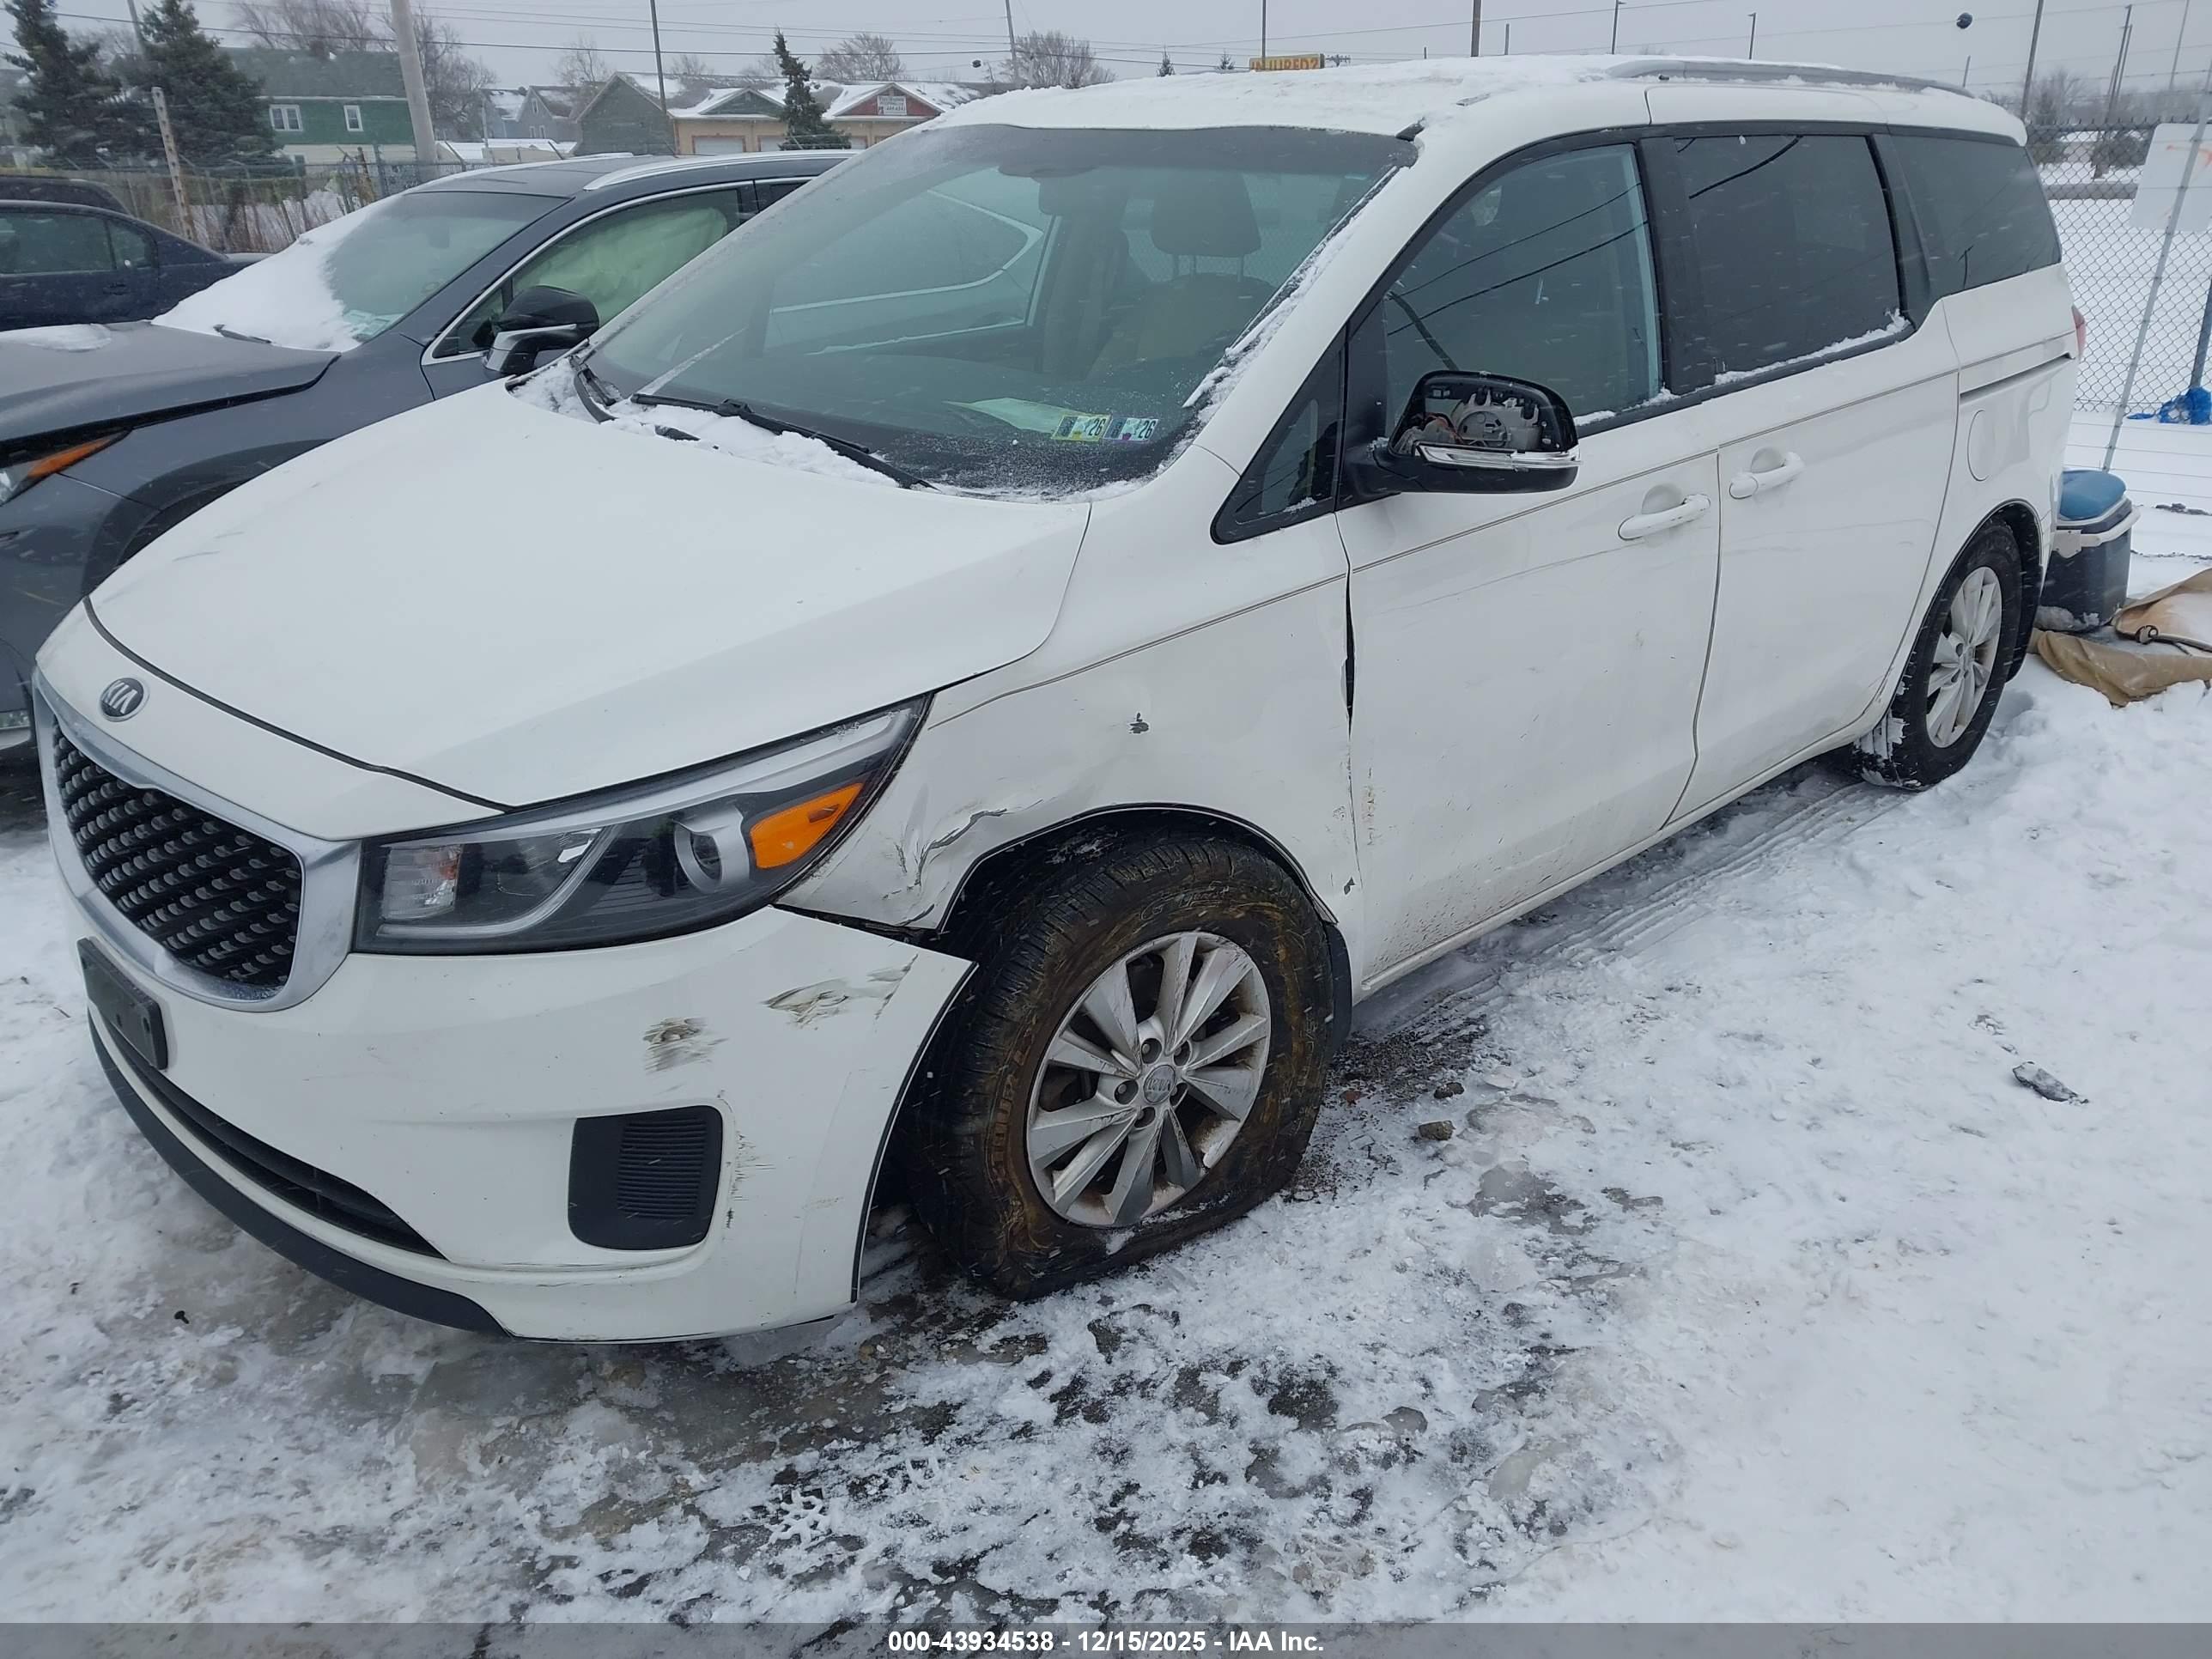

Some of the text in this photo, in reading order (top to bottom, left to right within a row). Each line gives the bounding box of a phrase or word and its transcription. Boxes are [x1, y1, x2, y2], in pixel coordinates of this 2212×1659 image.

[1089, 417, 1106, 436] 26
[1138, 420, 1156, 439] 26
[101, 680, 138, 714] KIA
